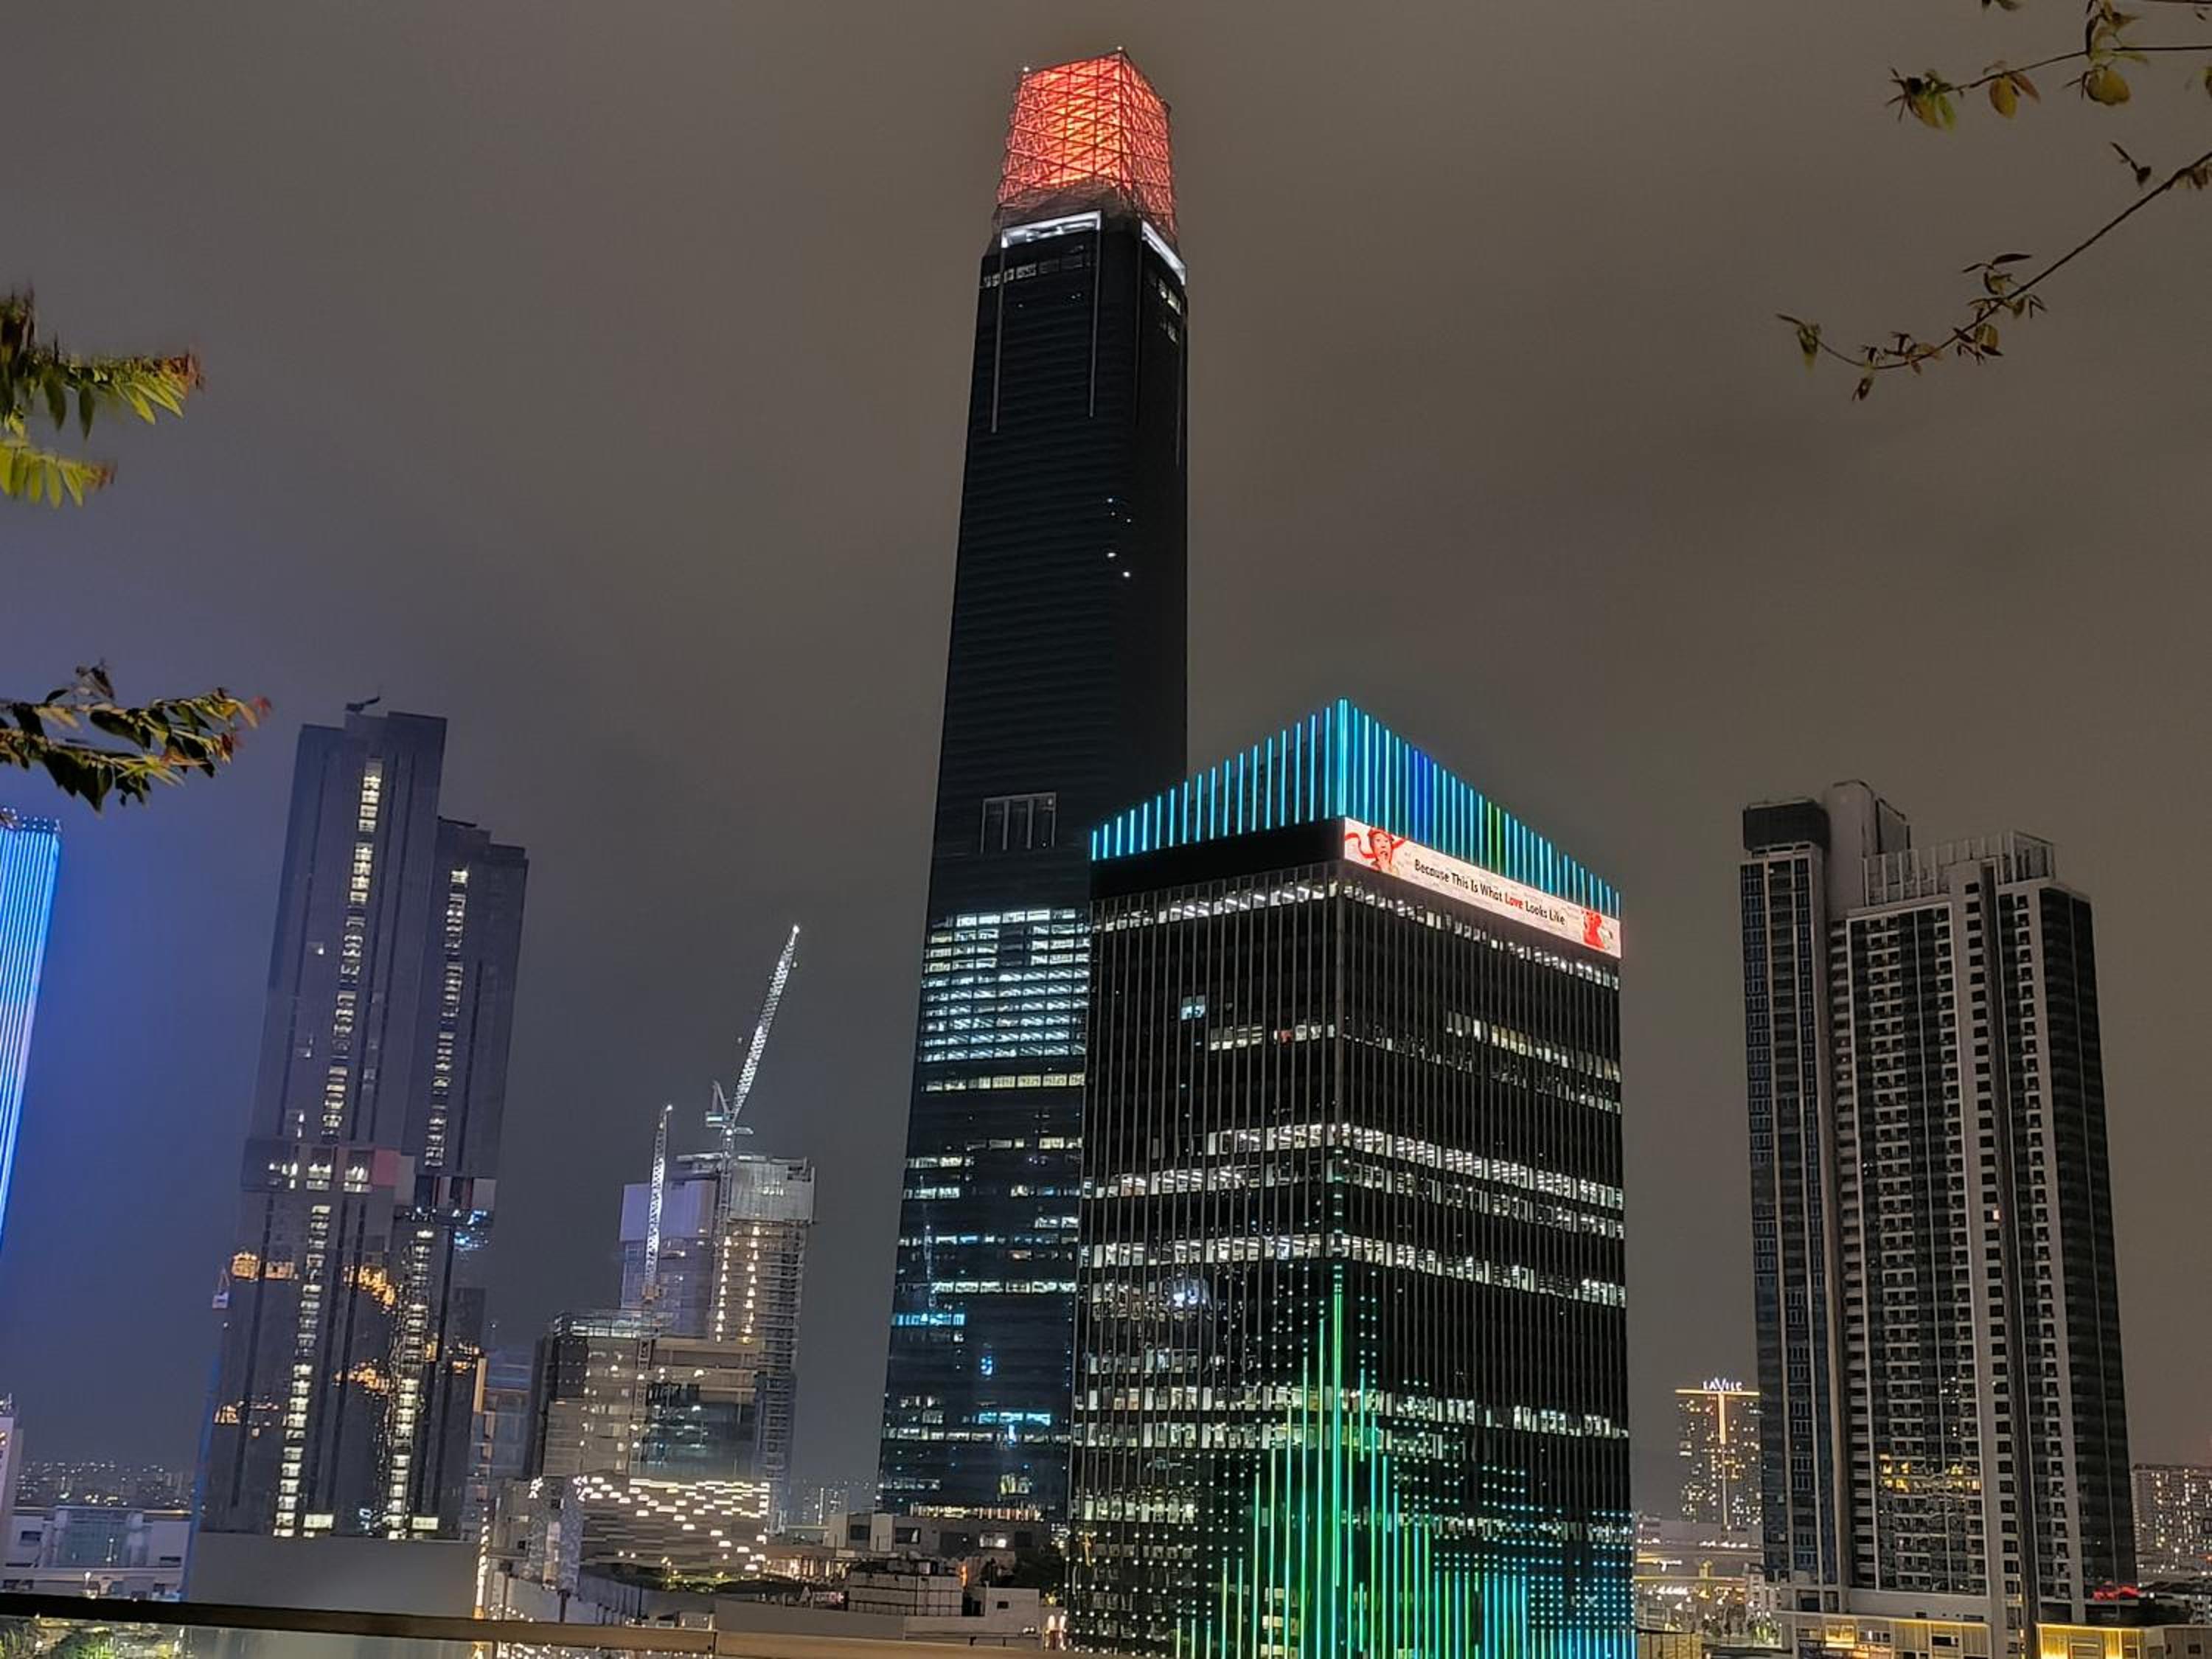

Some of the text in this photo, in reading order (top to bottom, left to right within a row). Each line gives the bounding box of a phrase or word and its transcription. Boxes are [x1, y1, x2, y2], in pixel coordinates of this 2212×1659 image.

[1415, 858, 1566, 925] Because This Is What Love Looks Like
